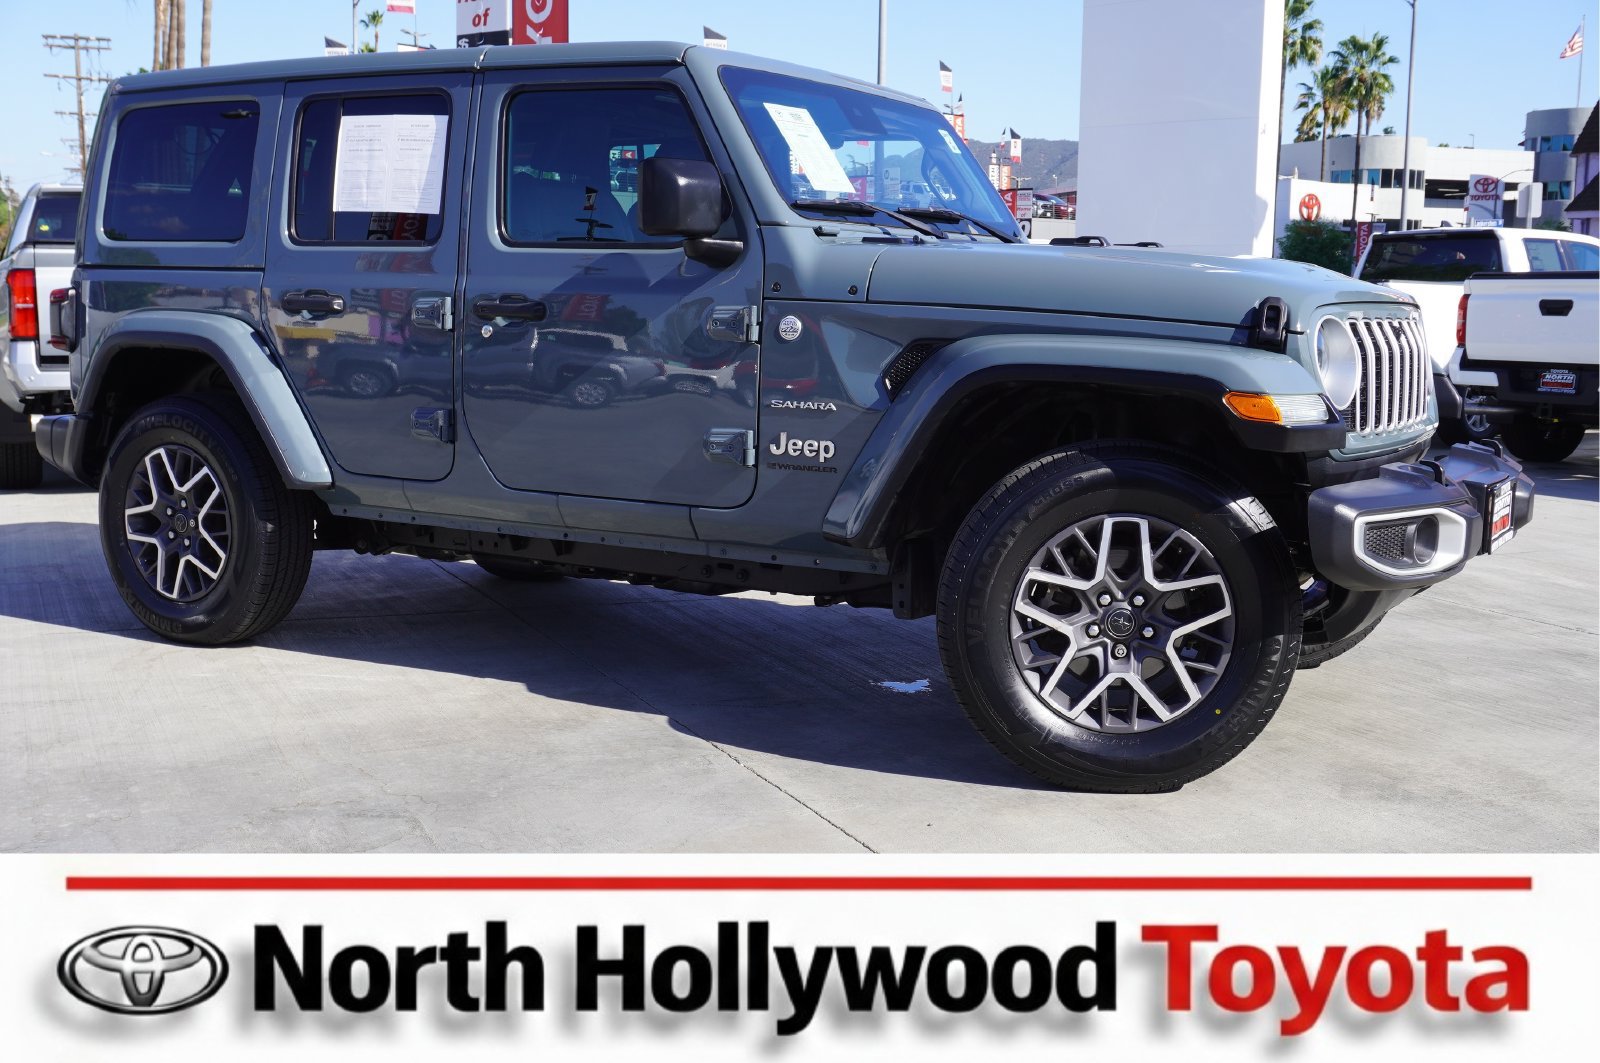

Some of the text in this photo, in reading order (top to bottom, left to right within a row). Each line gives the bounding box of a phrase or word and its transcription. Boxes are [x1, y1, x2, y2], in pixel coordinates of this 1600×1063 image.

[472, 7, 491, 27] of
[770, 399, 837, 411] SAHARA
[769, 431, 835, 463] Jeep
[777, 463, 838, 474] WRANGLER
